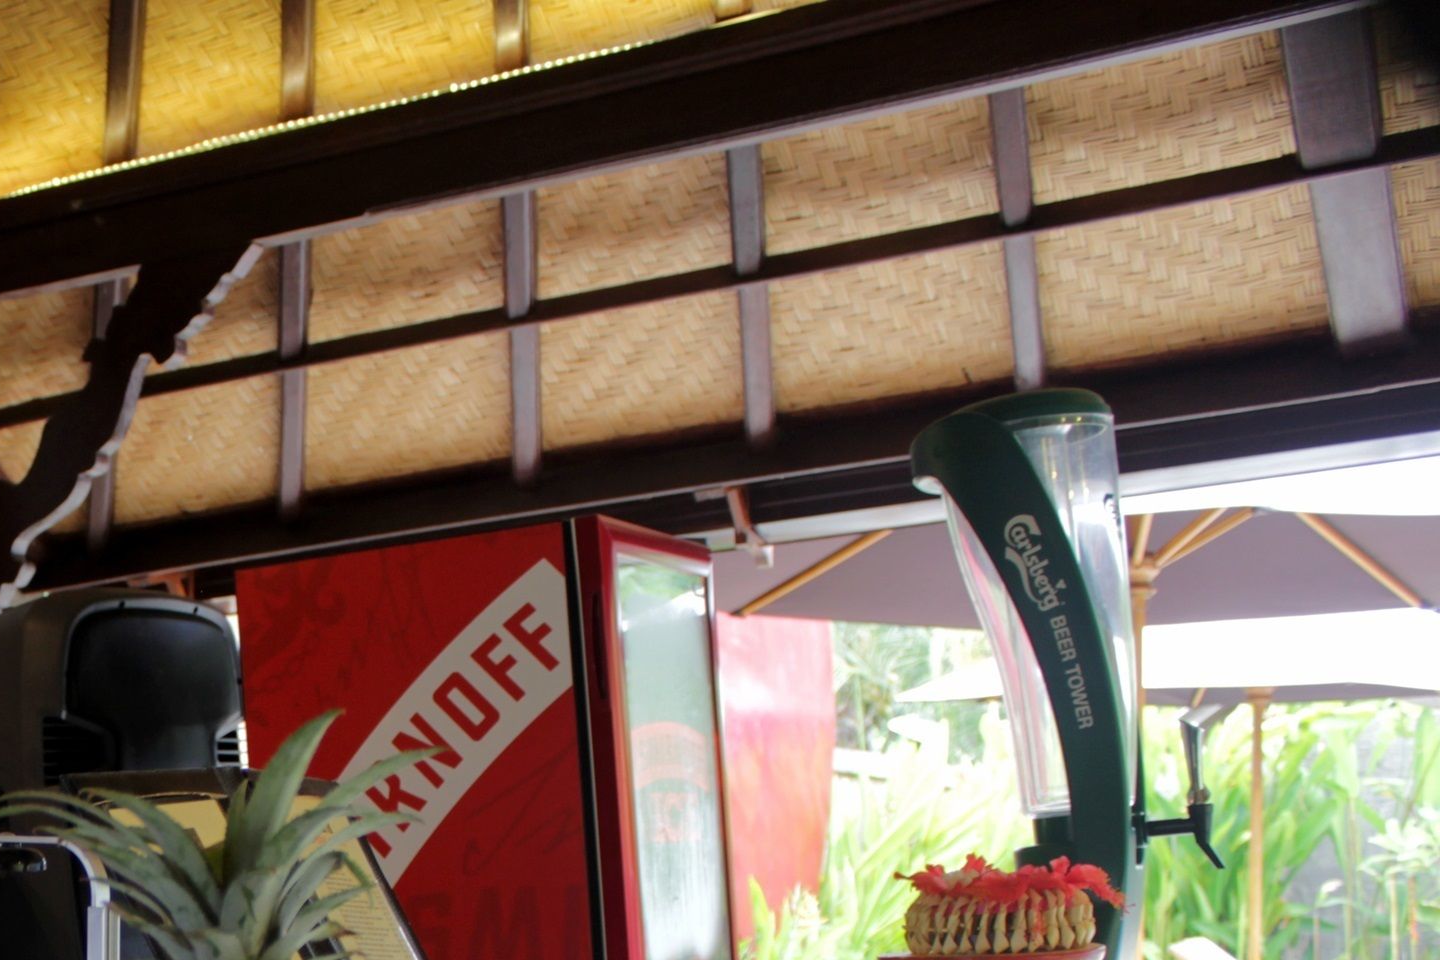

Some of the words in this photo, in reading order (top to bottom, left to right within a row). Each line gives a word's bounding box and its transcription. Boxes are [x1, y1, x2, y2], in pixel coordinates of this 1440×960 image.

[1004, 513, 1062, 612] Carlsberg
[1050, 614, 1077, 663] BEER
[1064, 662, 1095, 731] TOWER
